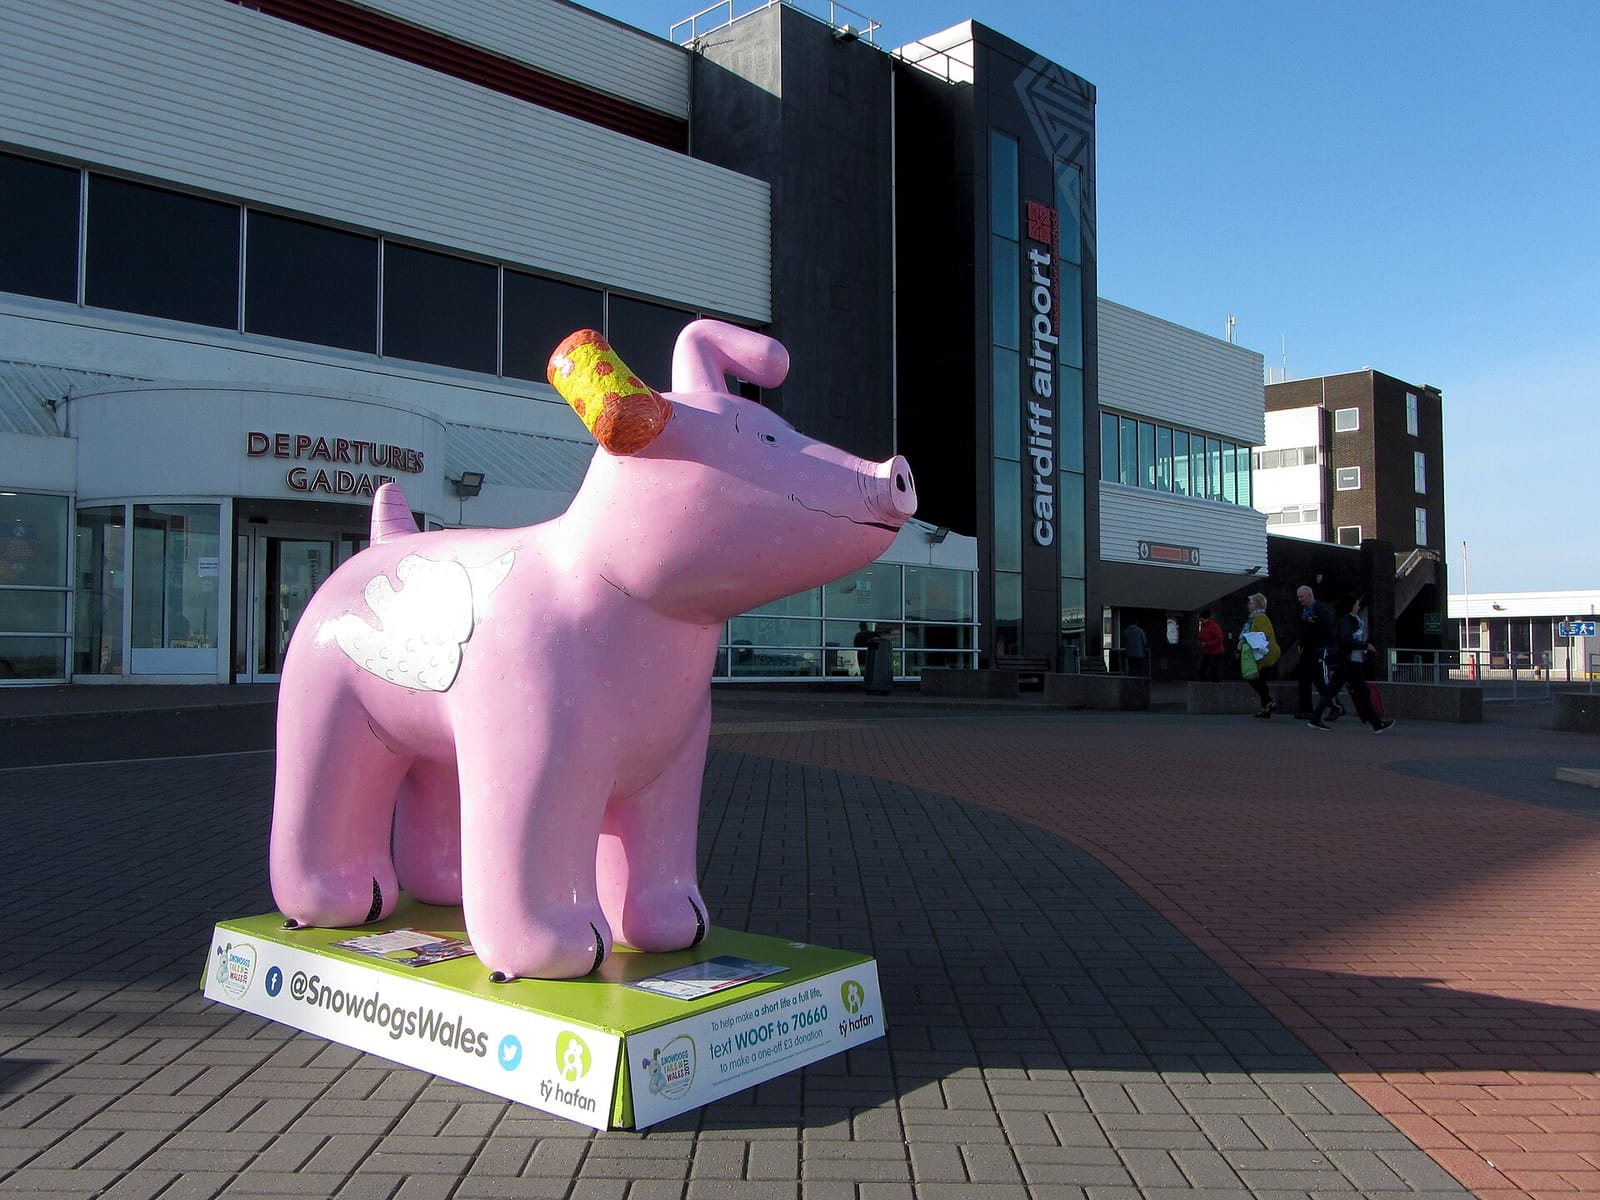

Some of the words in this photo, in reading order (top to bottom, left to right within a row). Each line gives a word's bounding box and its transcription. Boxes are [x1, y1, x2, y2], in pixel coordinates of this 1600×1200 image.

[1027, 248, 1058, 400] airport
[247, 431, 425, 474] DEPARTURES
[1027, 401, 1053, 546] cardiff
[286, 467, 398, 497] GADA
[290, 970, 489, 1058] @SnowdogsWales
[709, 1038, 732, 1060] text
[735, 1024, 774, 1051] WOOF
[777, 1021, 789, 1036] to
[791, 1005, 828, 1031] 70660
[711, 1022, 719, 1031] To
[719, 1017, 735, 1030] help
[736, 1010, 754, 1025] make
[755, 1008, 760, 1018] a
[761, 1001, 779, 1016] short
[780, 998, 791, 1010] life
[792, 996, 798, 1005] a
[798, 991, 809, 1004] full
[848, 1014, 874, 1032] hafan
[720, 1063, 728, 1073] to
[729, 1055, 750, 1071] make
[751, 1053, 757, 1062] a
[757, 1041, 783, 1060] one-off
[784, 1038, 793, 1050] £3
[794, 1029, 823, 1047] donation
[667, 1069, 684, 1082] WALES
[555, 1083, 597, 1113] hafan
